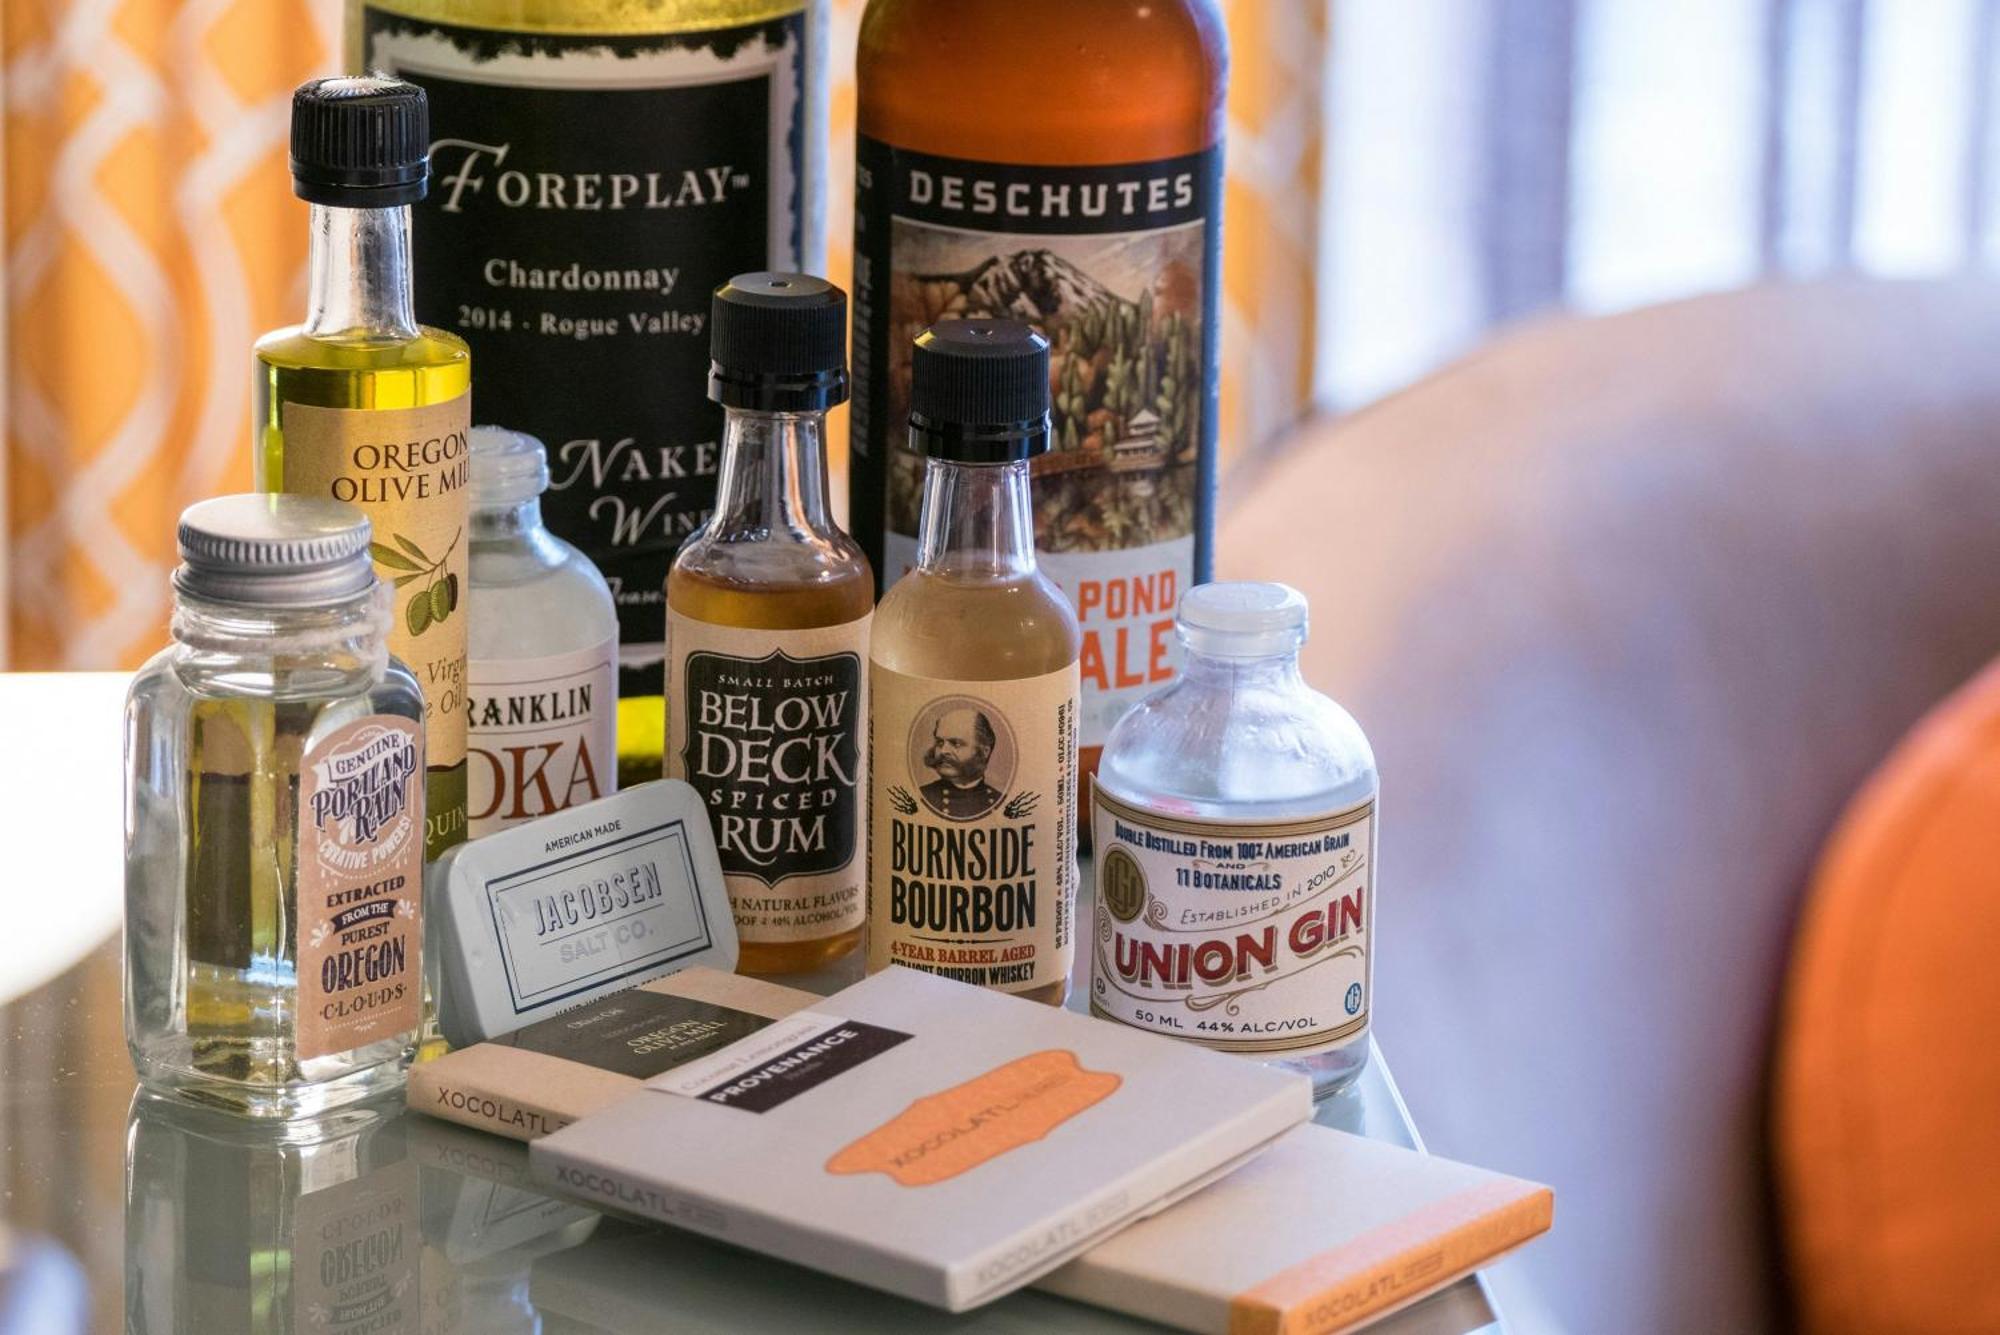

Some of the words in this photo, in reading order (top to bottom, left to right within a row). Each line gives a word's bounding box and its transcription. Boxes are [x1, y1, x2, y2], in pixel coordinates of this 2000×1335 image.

[910, 170, 1194, 217] DESCHUTES
[484, 258, 679, 295] Chardonnay
[459, 305, 512, 331] 2014
[540, 312, 619, 340] Rogue
[629, 310, 705, 335] Valley
[353, 427, 467, 473] OREGON
[331, 473, 431, 503] OLIVE
[1078, 569, 1176, 622] POND
[1081, 618, 1176, 691] ALE
[718, 674, 773, 688] SMALL
[784, 674, 833, 688] BATCH
[700, 689, 848, 733] BELOW
[336, 733, 400, 774] GENUINE
[697, 731, 857, 787] DECK
[310, 744, 416, 832] PORTLAND
[710, 788, 837, 810] SPICED
[350, 781, 406, 844] RAIN
[545, 828, 593, 853] AMERICAN
[593, 819, 622, 840] MADE
[718, 814, 827, 866] RUM
[891, 818, 1036, 881] BURNSIDE
[1115, 820, 1143, 845] DOUBLE
[1145, 831, 1197, 857] DISTILLED
[1200, 840, 1233, 860] FROM
[1265, 839, 1322, 860] AMERICAN
[1323, 832, 1350, 852] GRAIN
[1176, 868, 1188, 888] 11
[1193, 870, 1282, 890] BOTANICALS
[1215, 862, 1246, 870] AND
[326, 875, 406, 908] EXTRACTED
[535, 862, 662, 936] JACOBSEN
[741, 897, 809, 912] NATURAL
[891, 875, 1036, 933] BOURBON
[1180, 896, 1280, 925] ESTABLISHED
[1287, 889, 1301, 902] IN
[1307, 864, 1336, 891] 2010
[341, 906, 371, 926] FROM
[371, 902, 389, 917] THE
[341, 921, 391, 946] PUREST
[559, 929, 610, 964] SALT
[615, 919, 655, 946] CO.
[937, 948, 998, 965] BARREL
[1001, 944, 1036, 963] AGED
[1115, 926, 1278, 990] UNION
[1288, 887, 1364, 959] GIN
[322, 935, 406, 995] OREGON
[989, 961, 1036, 987] WHISKEY
[1135, 1009, 1154, 1023] 50
[1160, 1016, 1184, 1029] ML
[1197, 1020, 1234, 1034] 44%
[1241, 1016, 1318, 1033] ALC/VOL
[710, 1028, 859, 1102] PROVENANCE
[437, 1086, 553, 1135] XOCOLATL
[556, 1165, 674, 1216] XOCOLATL
